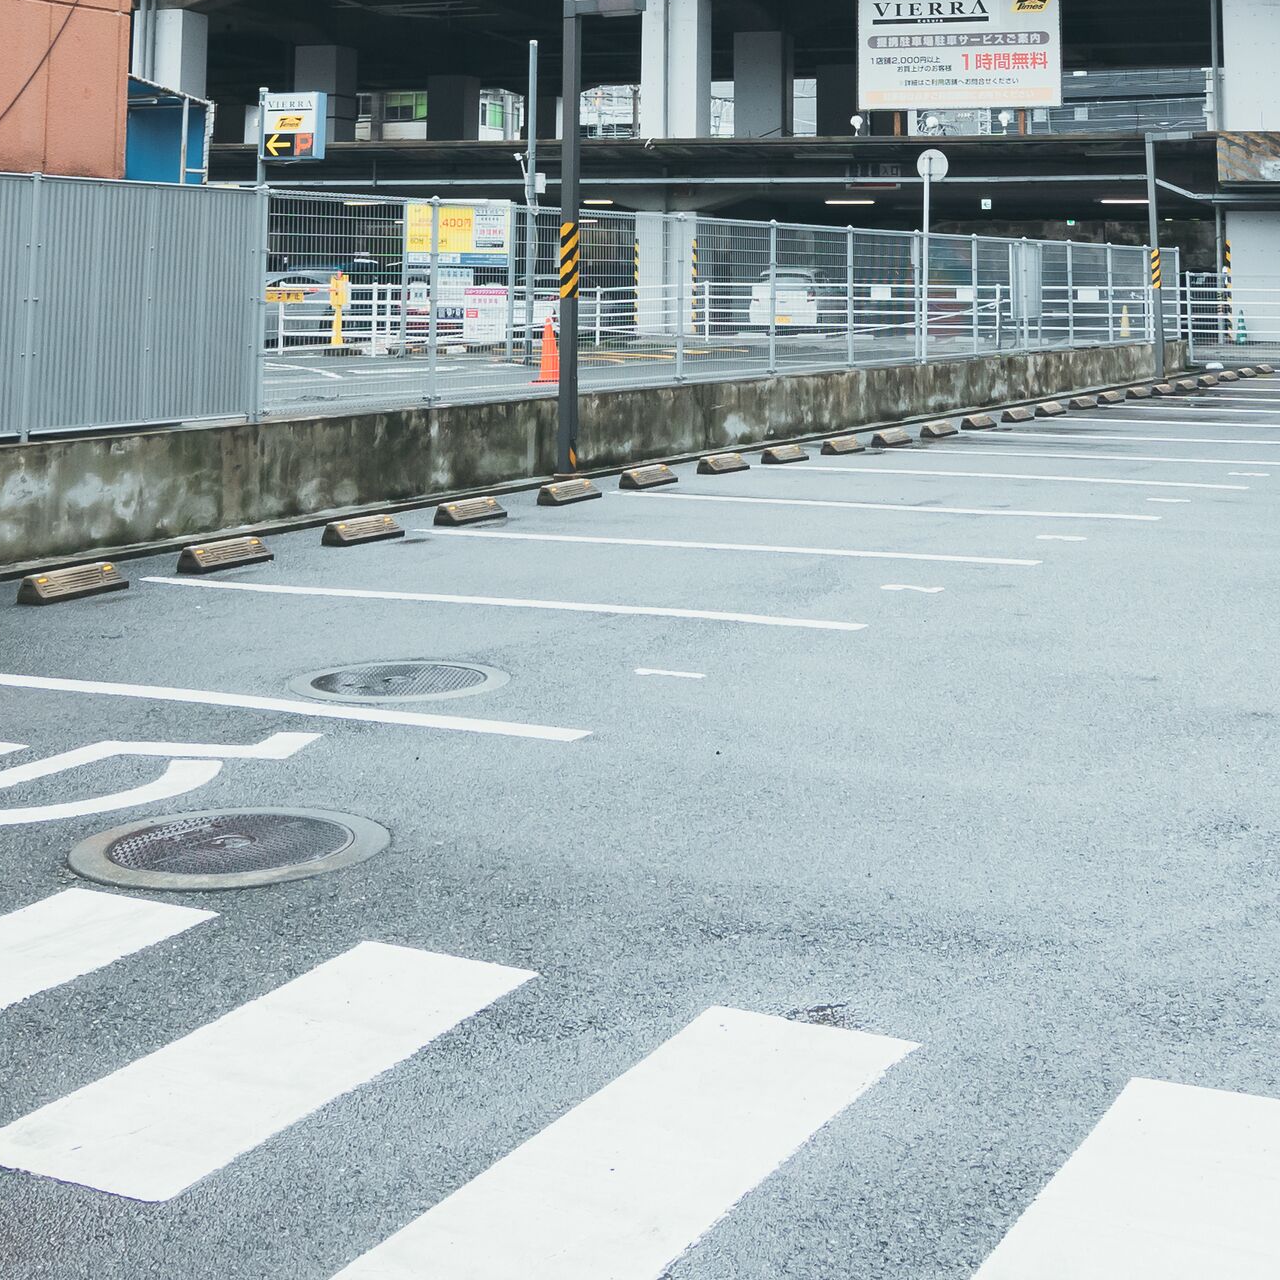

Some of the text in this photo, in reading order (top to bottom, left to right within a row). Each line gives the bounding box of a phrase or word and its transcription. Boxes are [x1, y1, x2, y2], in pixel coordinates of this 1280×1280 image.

[873, 0, 989, 17] VIERRA
[961, 51, 1048, 71] 1時間無料
[268, 100, 312, 108] VIERRA
[294, 133, 312, 156] P
